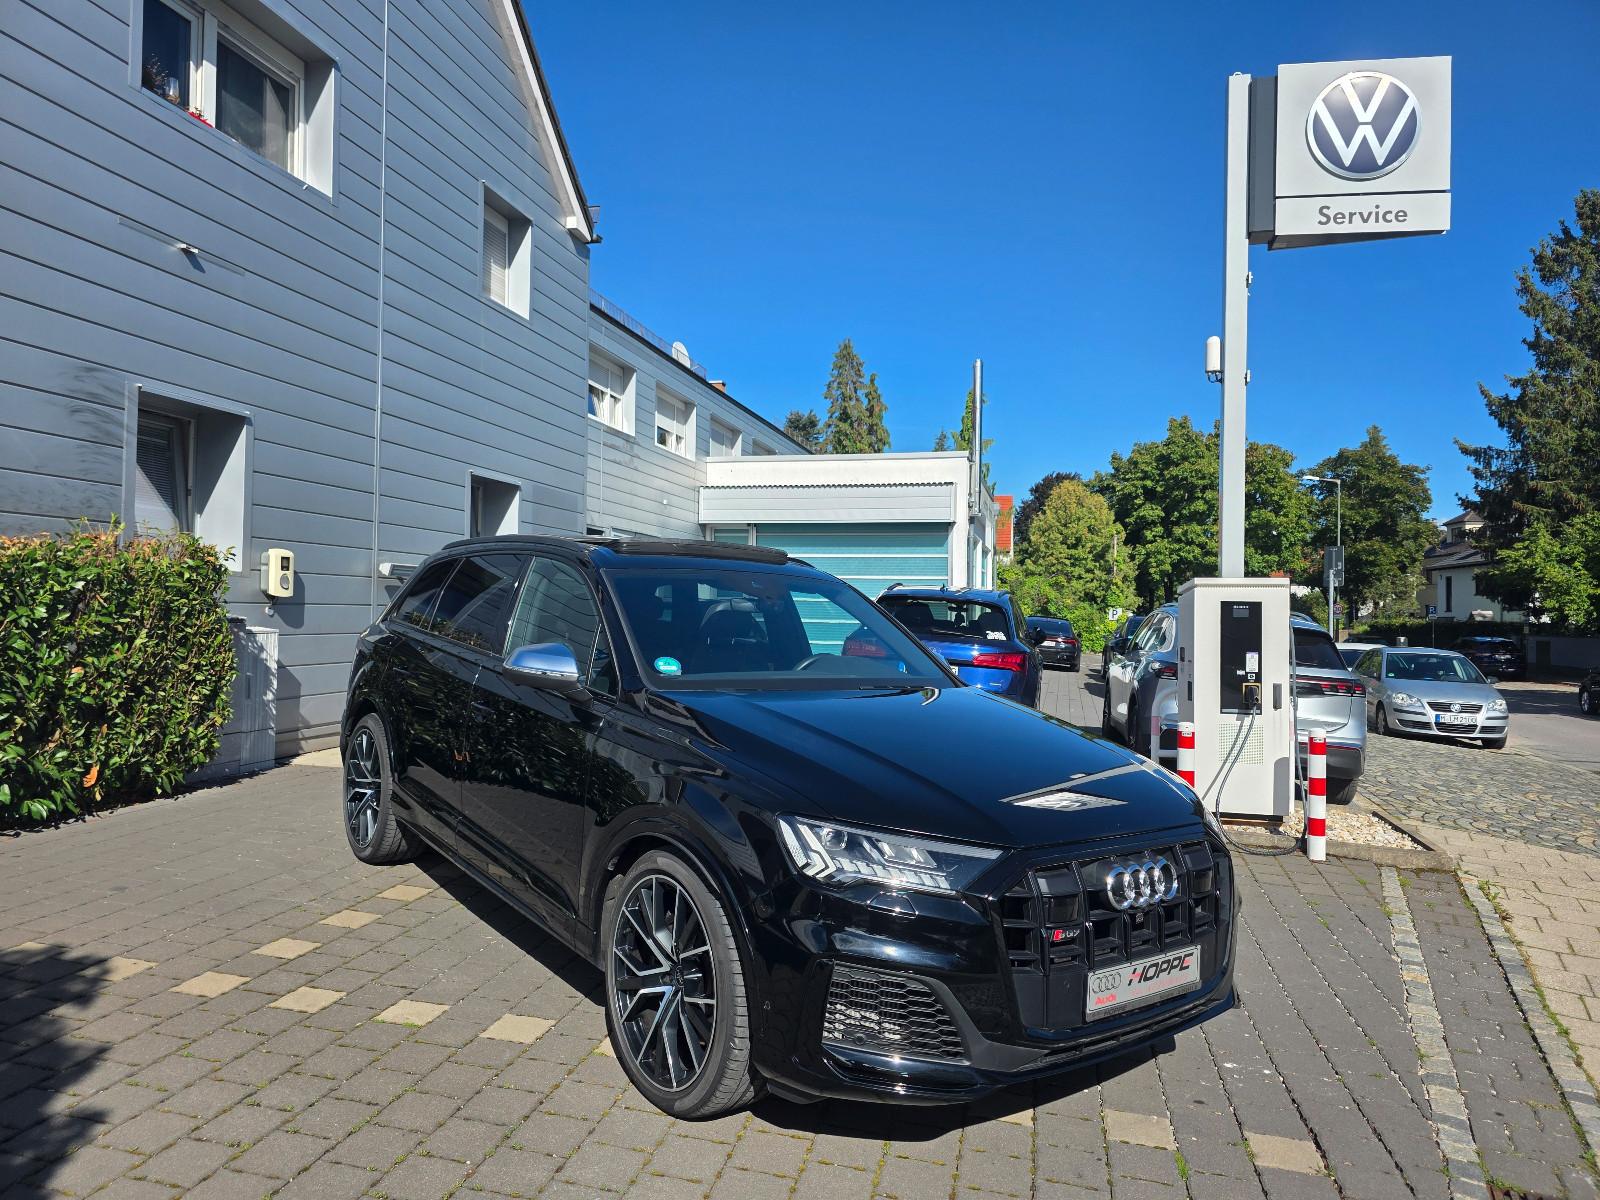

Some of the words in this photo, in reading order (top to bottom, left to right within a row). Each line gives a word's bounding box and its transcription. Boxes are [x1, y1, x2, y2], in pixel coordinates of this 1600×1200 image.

[1318, 205, 1408, 226] Service
[1128, 952, 1194, 986] HOPPE
[1095, 994, 1117, 1006] Audi
